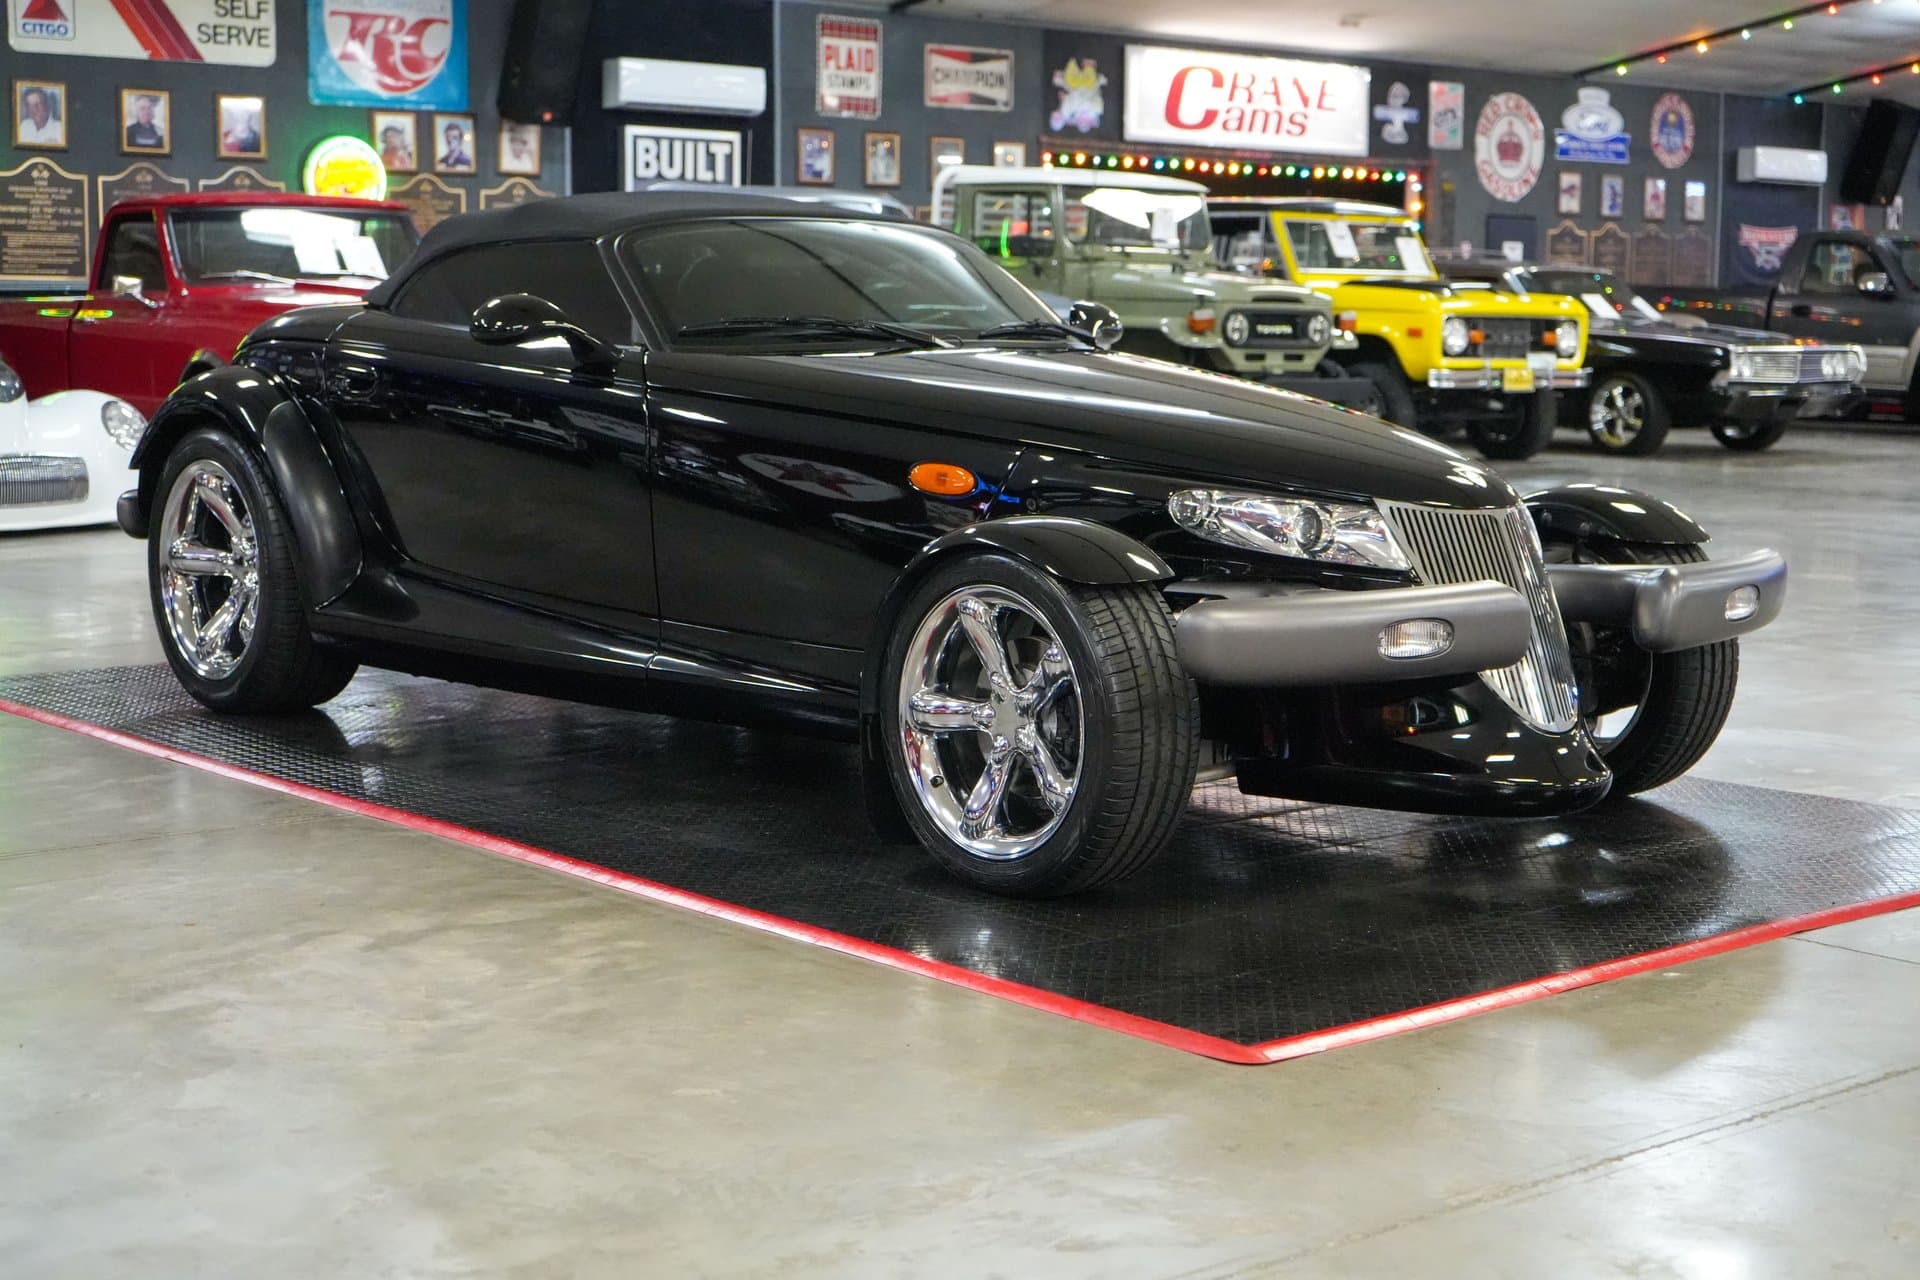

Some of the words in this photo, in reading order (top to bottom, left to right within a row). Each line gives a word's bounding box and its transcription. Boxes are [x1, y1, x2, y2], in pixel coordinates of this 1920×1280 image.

[214, 0, 269, 20] SELF
[22, 21, 69, 37] CITGO
[197, 23, 271, 48] SERVE
[330, 10, 450, 94] RC
[824, 44, 874, 73] PLAID
[635, 137, 732, 182] BUILT
[1255, 323, 1294, 335] TOYOTA
